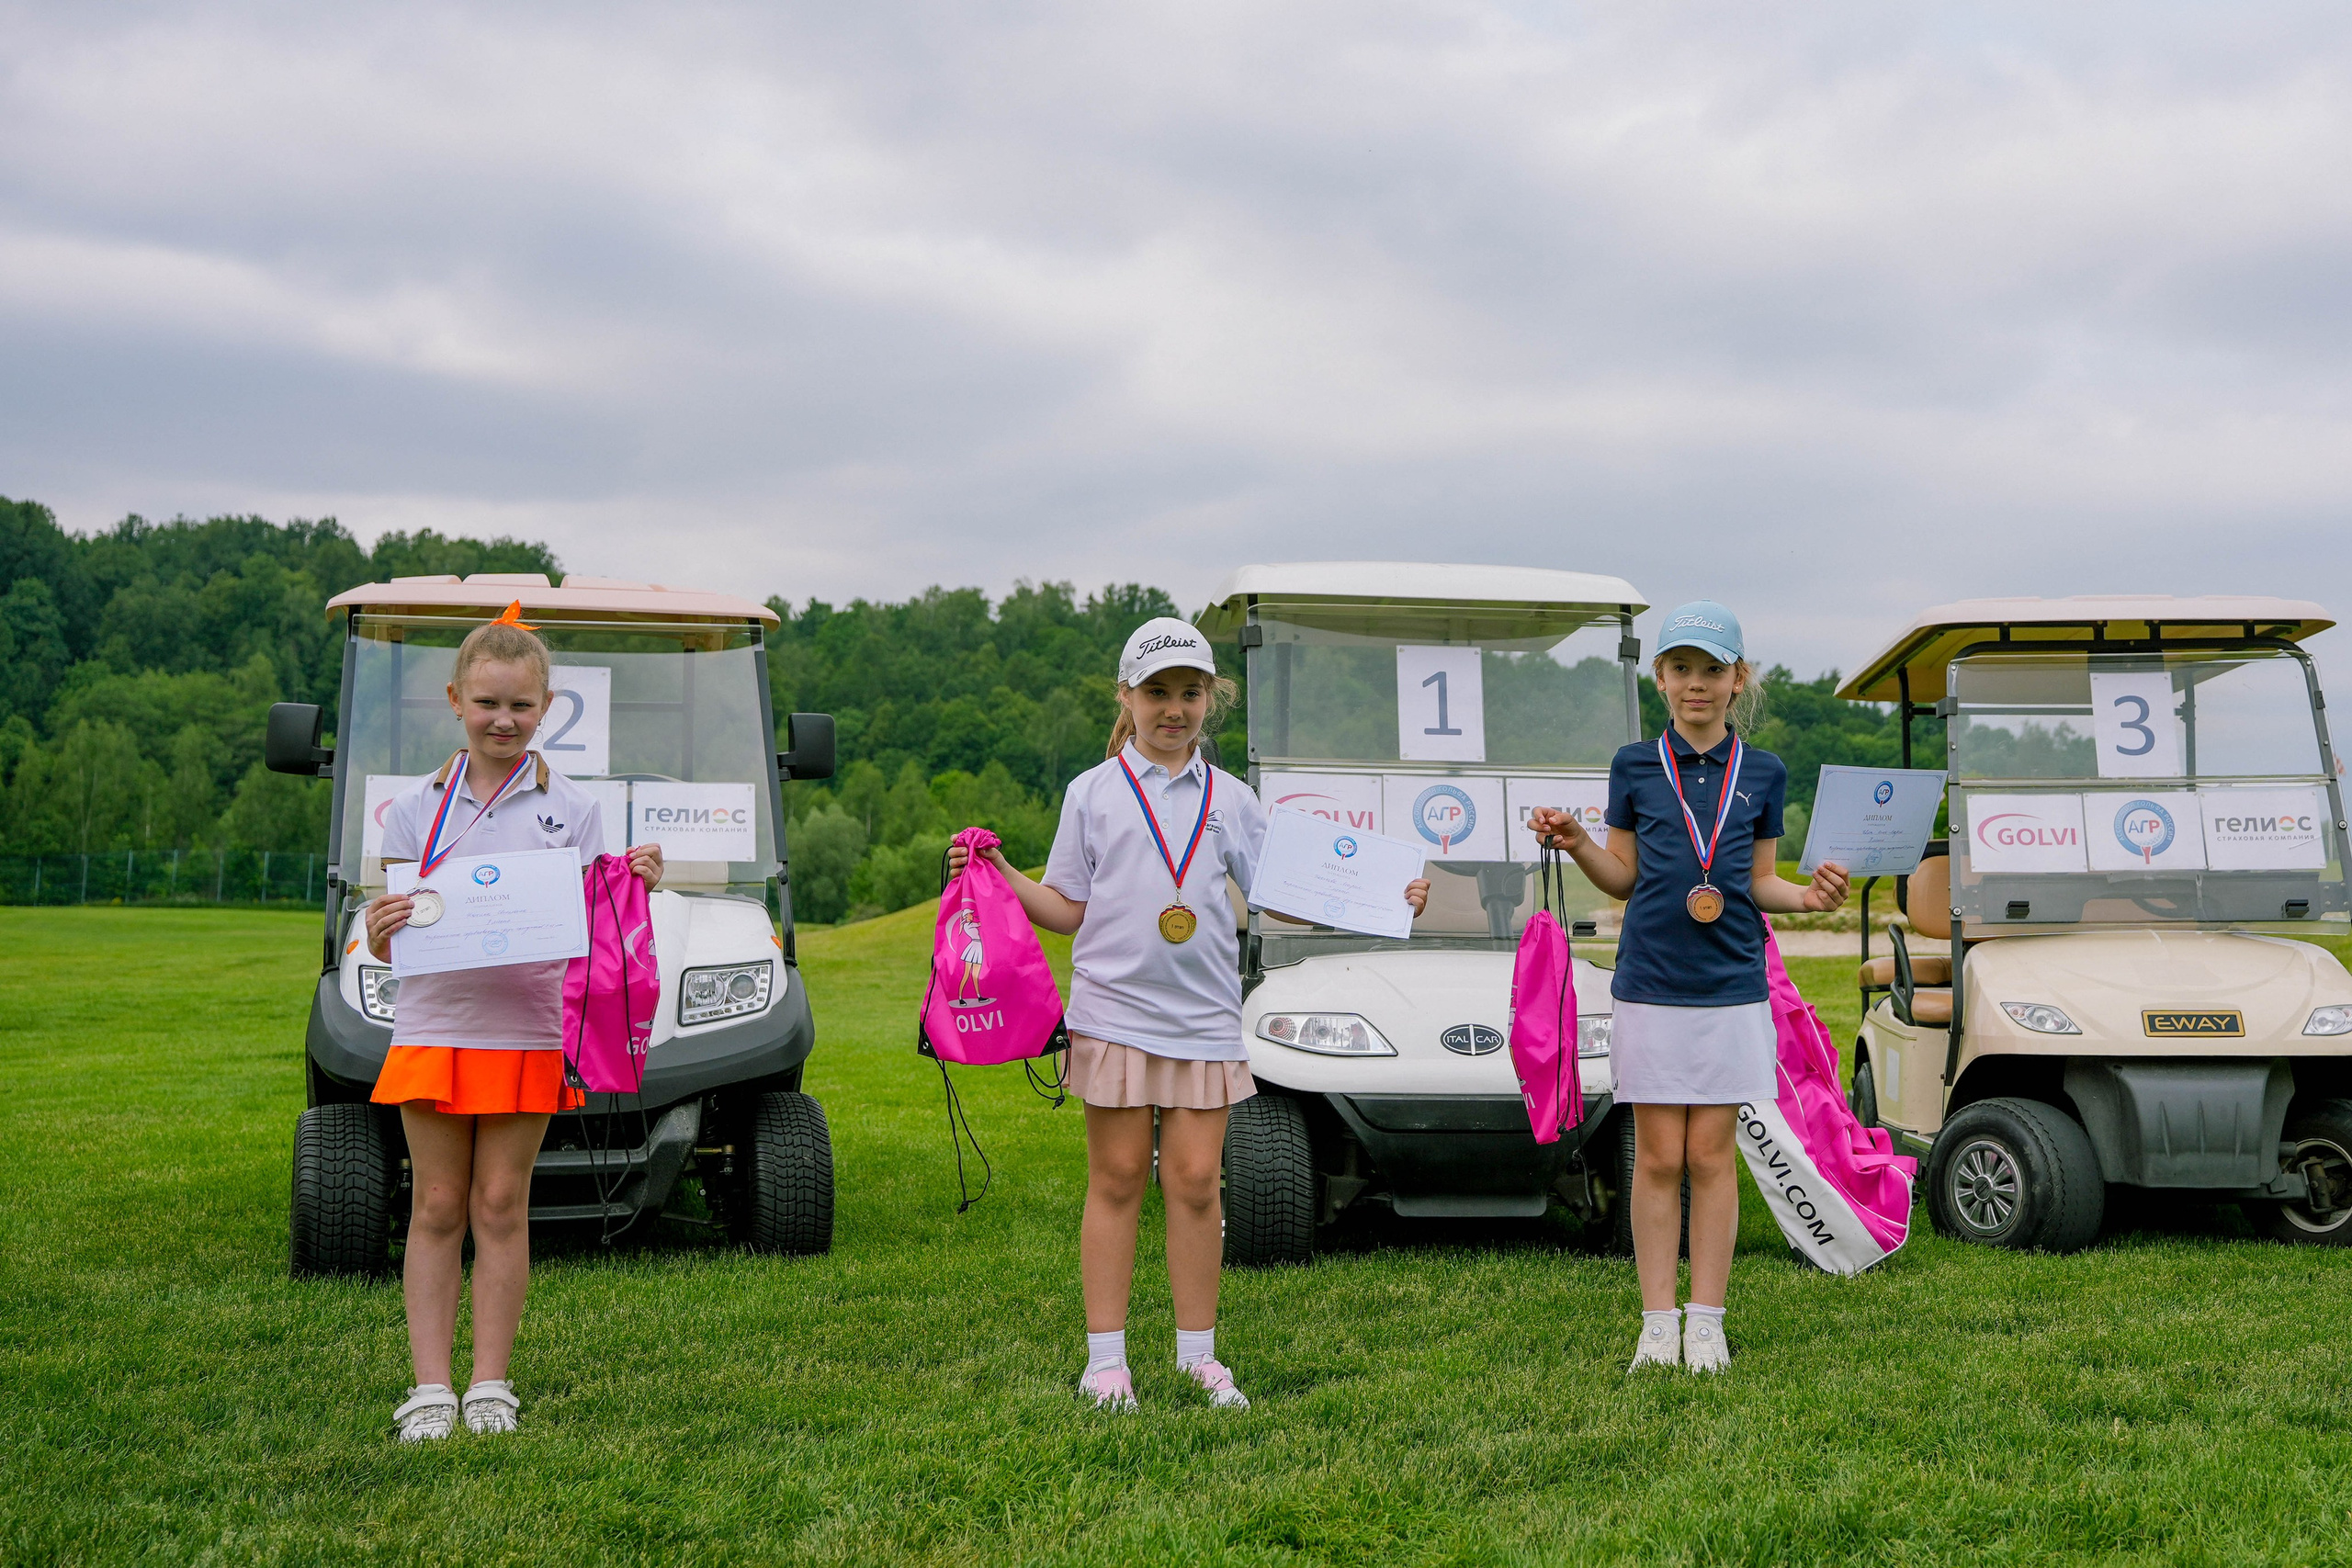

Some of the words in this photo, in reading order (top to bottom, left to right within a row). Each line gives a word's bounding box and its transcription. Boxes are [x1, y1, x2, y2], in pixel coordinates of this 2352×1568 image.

[1668, 615, 1725, 633] Titleist
[1136, 635, 1197, 660] Titleist
[1421, 671, 1463, 736] 1
[543, 689, 586, 751] 2
[2114, 694, 2155, 756] 3
[1427, 806, 1462, 821] АГР
[2128, 819, 2161, 834] АГР
[1997, 828, 2076, 846] GOLVI
[1321, 862, 1360, 877] ДИПЛОМ
[465, 893, 511, 905] ДИПЛОМ
[953, 1010, 1004, 1032] OLVI
[2154, 1016, 2231, 1030] EWAY
[1476, 1035, 1499, 1043] CAR
[1738, 1102, 1836, 1246] GOLVI.COM
